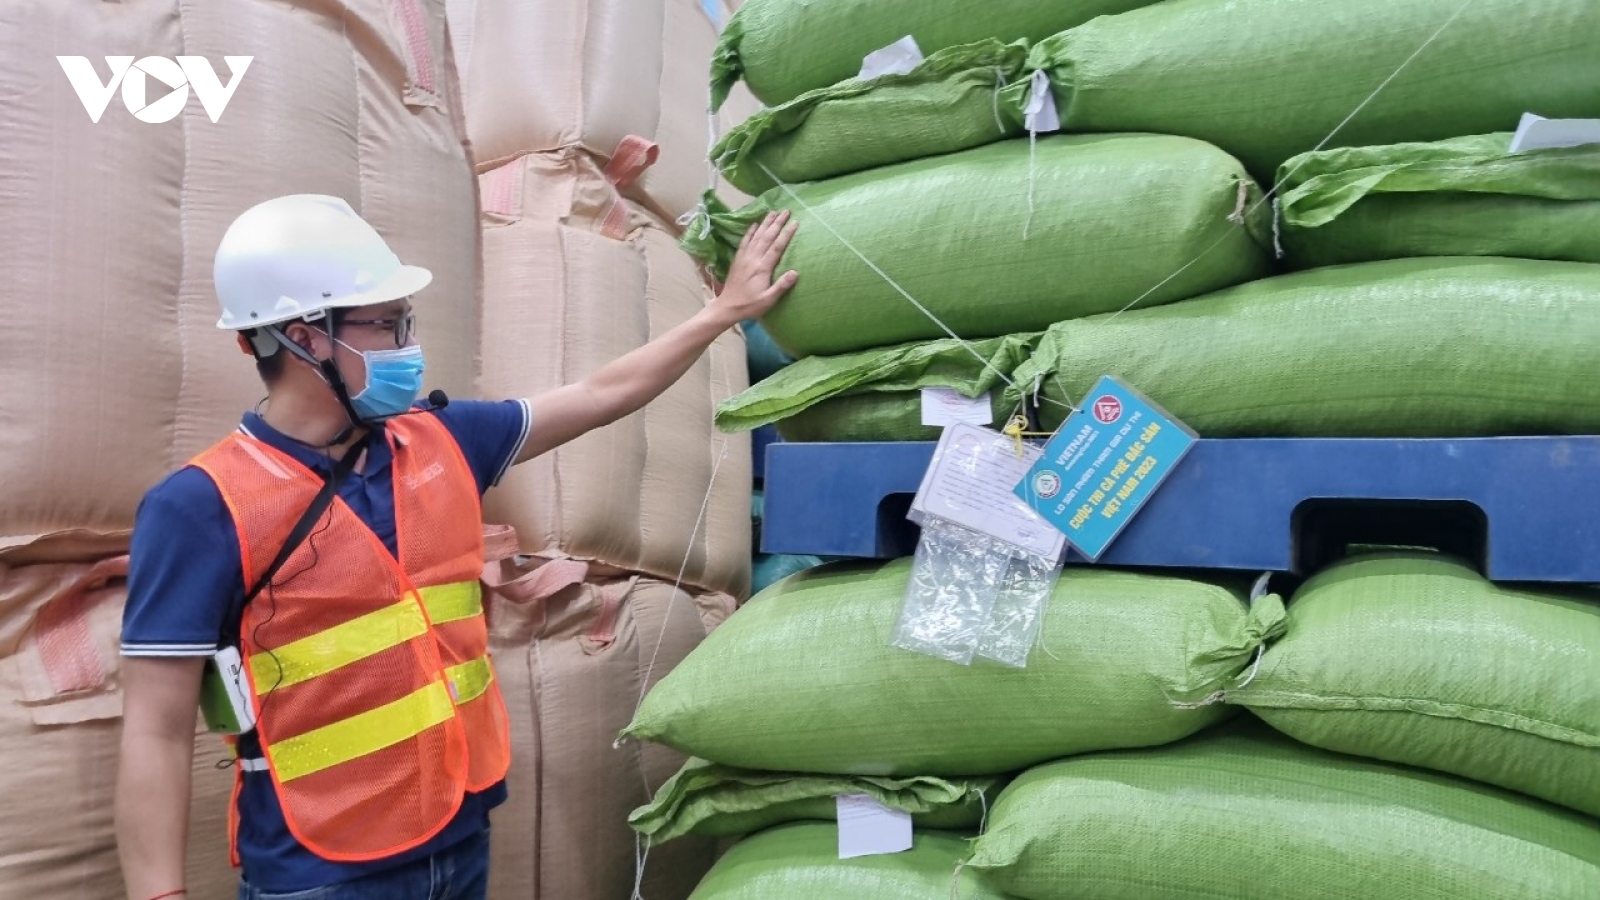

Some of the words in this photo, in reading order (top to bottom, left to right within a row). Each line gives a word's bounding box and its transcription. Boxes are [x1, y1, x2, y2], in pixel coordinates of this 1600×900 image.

[1055, 425, 1093, 465] VIETNAM
[1087, 490, 1105, 505] THI
[1101, 497, 1121, 518] VIỆT
[1116, 477, 1139, 500] NAM
[1135, 455, 1157, 480] 2023
